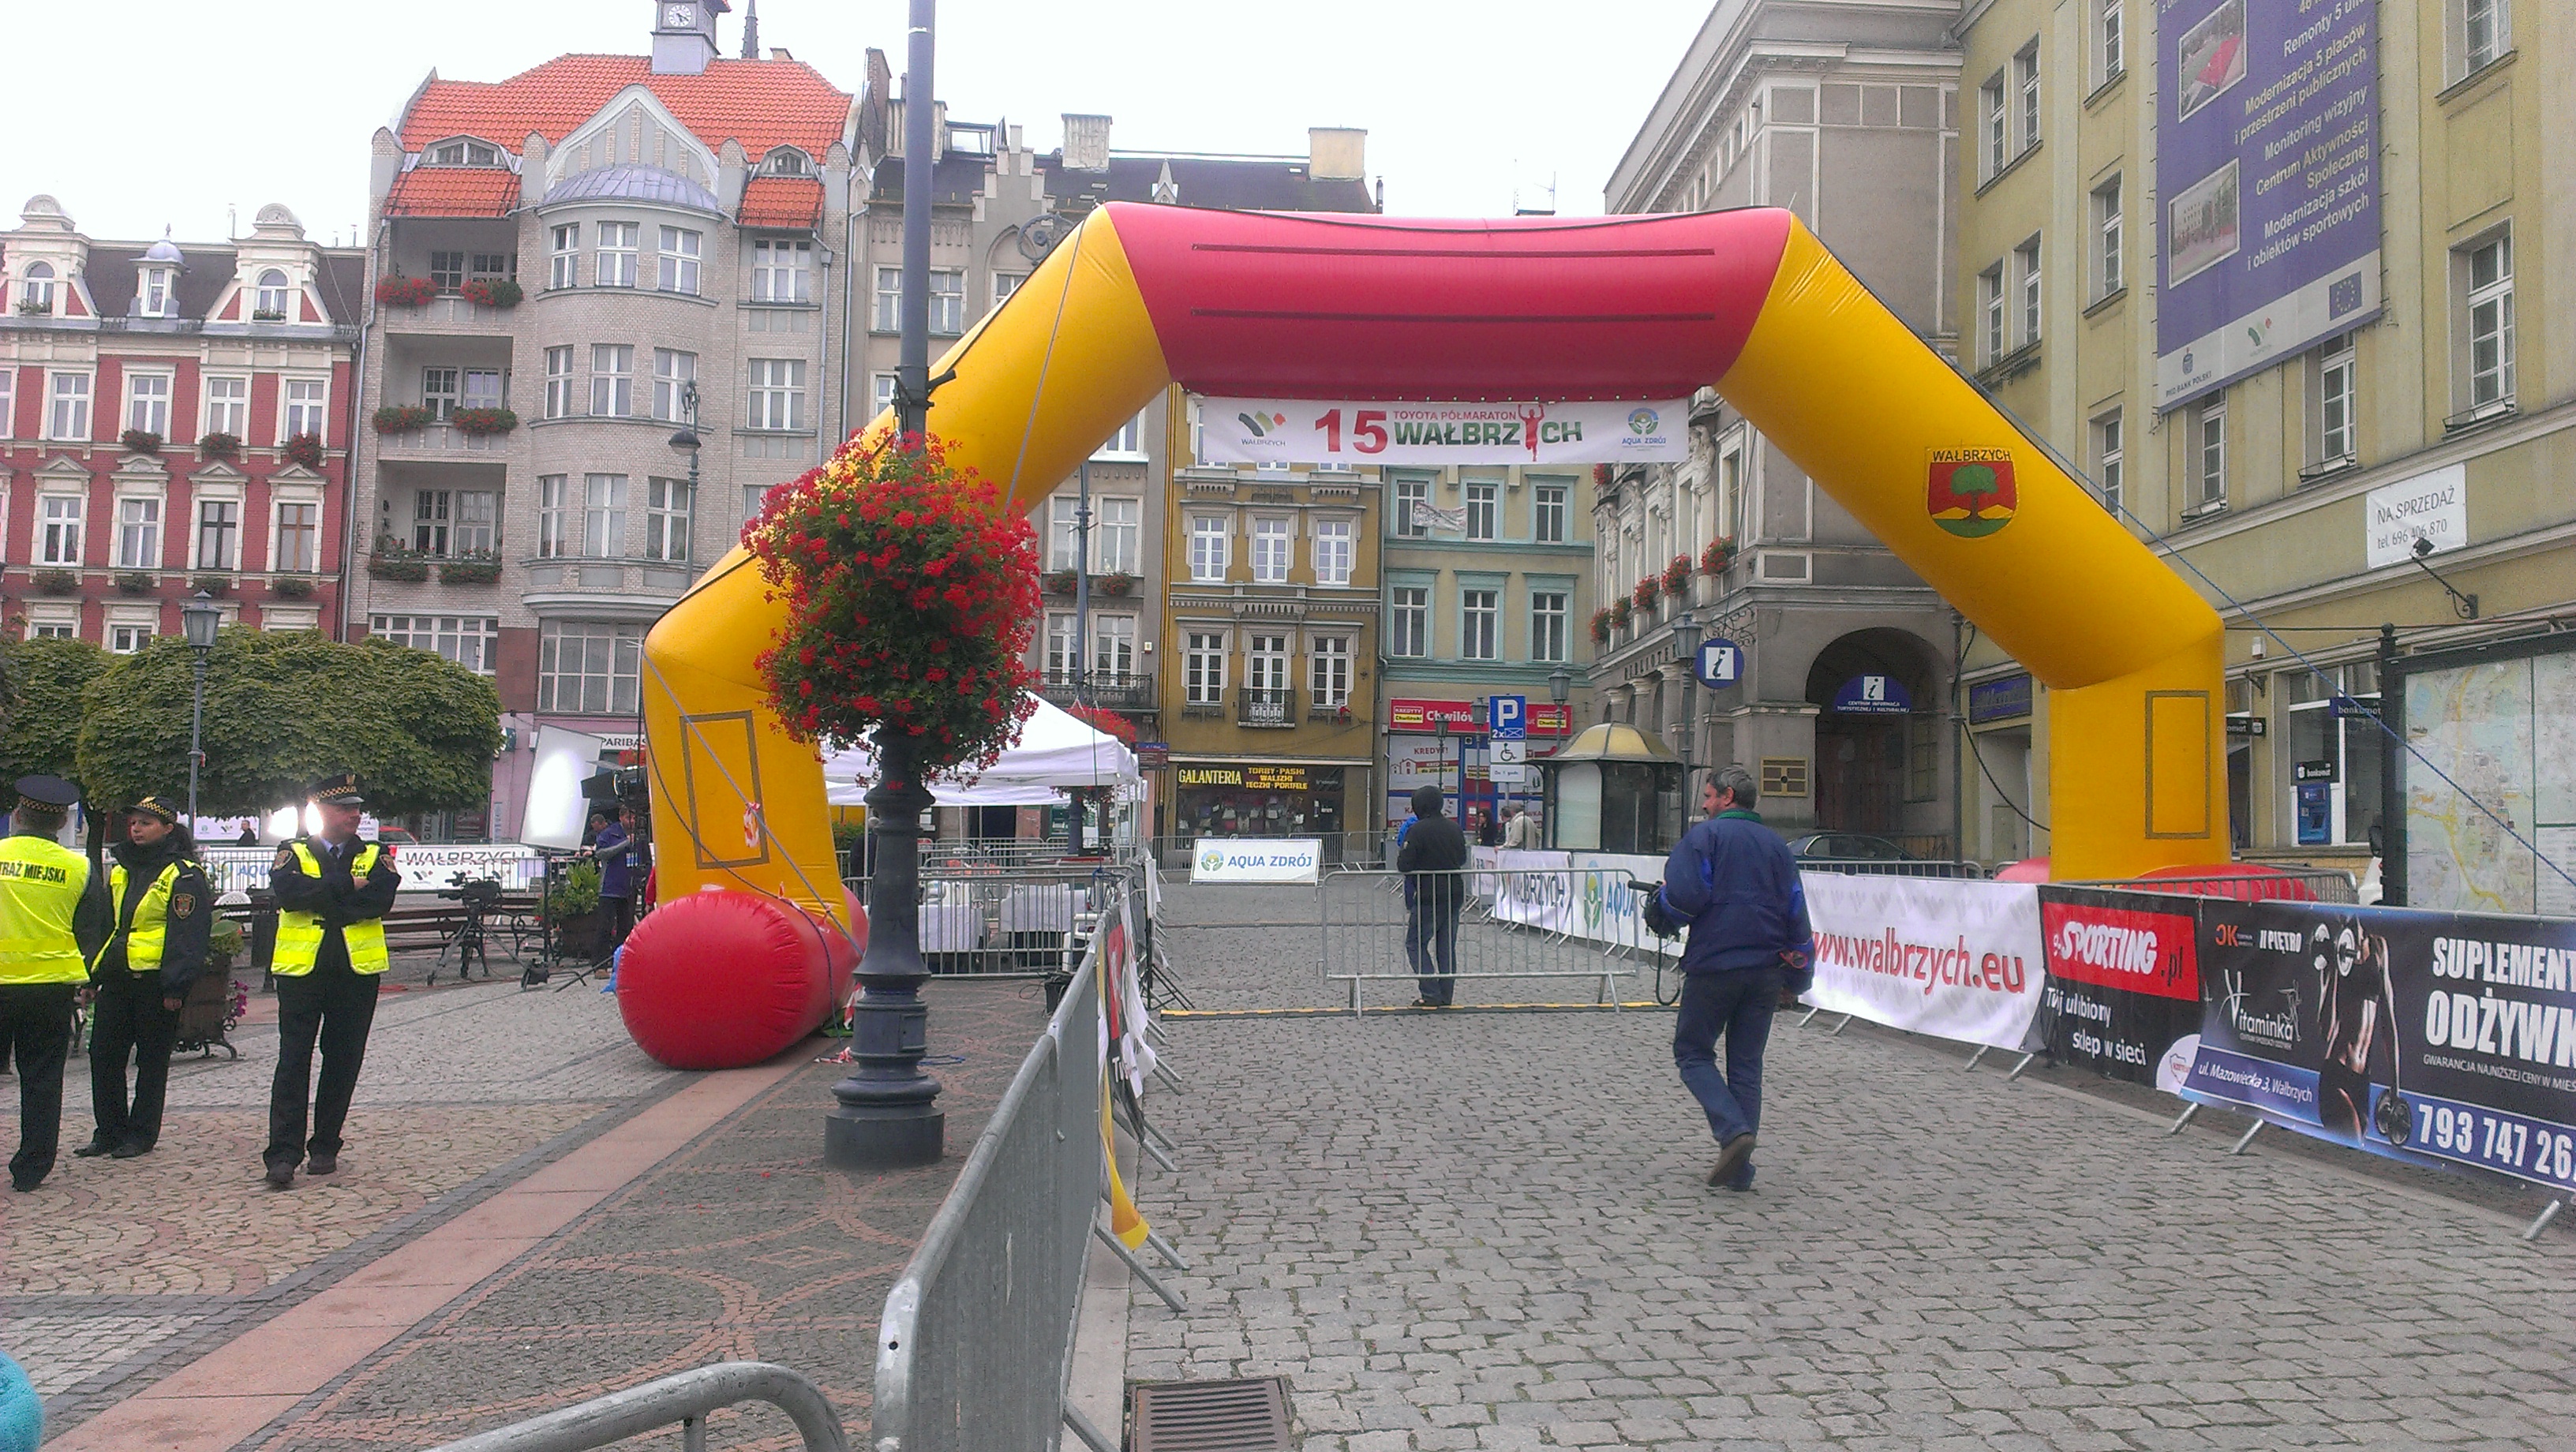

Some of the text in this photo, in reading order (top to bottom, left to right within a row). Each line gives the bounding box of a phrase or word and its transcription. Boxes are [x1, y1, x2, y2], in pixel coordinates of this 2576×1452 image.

[2283, 13, 2333, 57] Remonty
[2335, 2, 2342, 21] 5
[2245, 22, 2367, 115] Modernizacja 5 placów
[2234, 45, 2367, 145] i przestrzeni publicznych
[2264, 85, 2368, 161] Monitoring wizyjny
[2256, 114, 2368, 196] Centrum Aktywności
[2264, 165, 2369, 239] Modernizacja szkół
[2248, 193, 2369, 271] i obiektów sportowych
[1315, 409, 1388, 455] 15
[1393, 409, 1516, 421] TOYOTA PÓŁMARATON
[1241, 438, 1286, 447] WAŁBRZYCH
[1622, 436, 1667, 447] AQUA ZDRÓJ
[1933, 449, 2012, 462] WAŁBRZYCH
[2376, 485, 2455, 525] NA SPRZEDAŻ
[2392, 528, 2409, 546] 696
[2429, 518, 2447, 536] 870
[1178, 769, 1242, 785] GALANTERIA
[1274, 781, 1309, 790] PORTFELE
[24, 863, 66, 884] MIEJSKA
[1227, 852, 1312, 867] AQUA ZDRÓJ
[1606, 881, 1635, 918] AQUA
[2260, 930, 2267, 949] II
[2268, 930, 2302, 954] PIĘTRO
[1811, 926, 2025, 995] ww.walbrzych.eu
[2216, 968, 2294, 1041] Vitaminka
[2104, 1039, 2114, 1057] w
[2115, 1038, 2147, 1066] sieci
[2199, 1063, 2208, 1076] ul.
[2210, 1064, 2263, 1088] Mazowiecka
[2260, 1076, 2271, 1093] 3,
[2423, 1053, 2477, 1073] GWARANCJA
[2477, 1062, 2521, 1082] NAJNIŻSZEJ
[2522, 1071, 2542, 1086] CENY
[2542, 1075, 2552, 1088] W
[2418, 1103, 2576, 1183] 793 747 26
